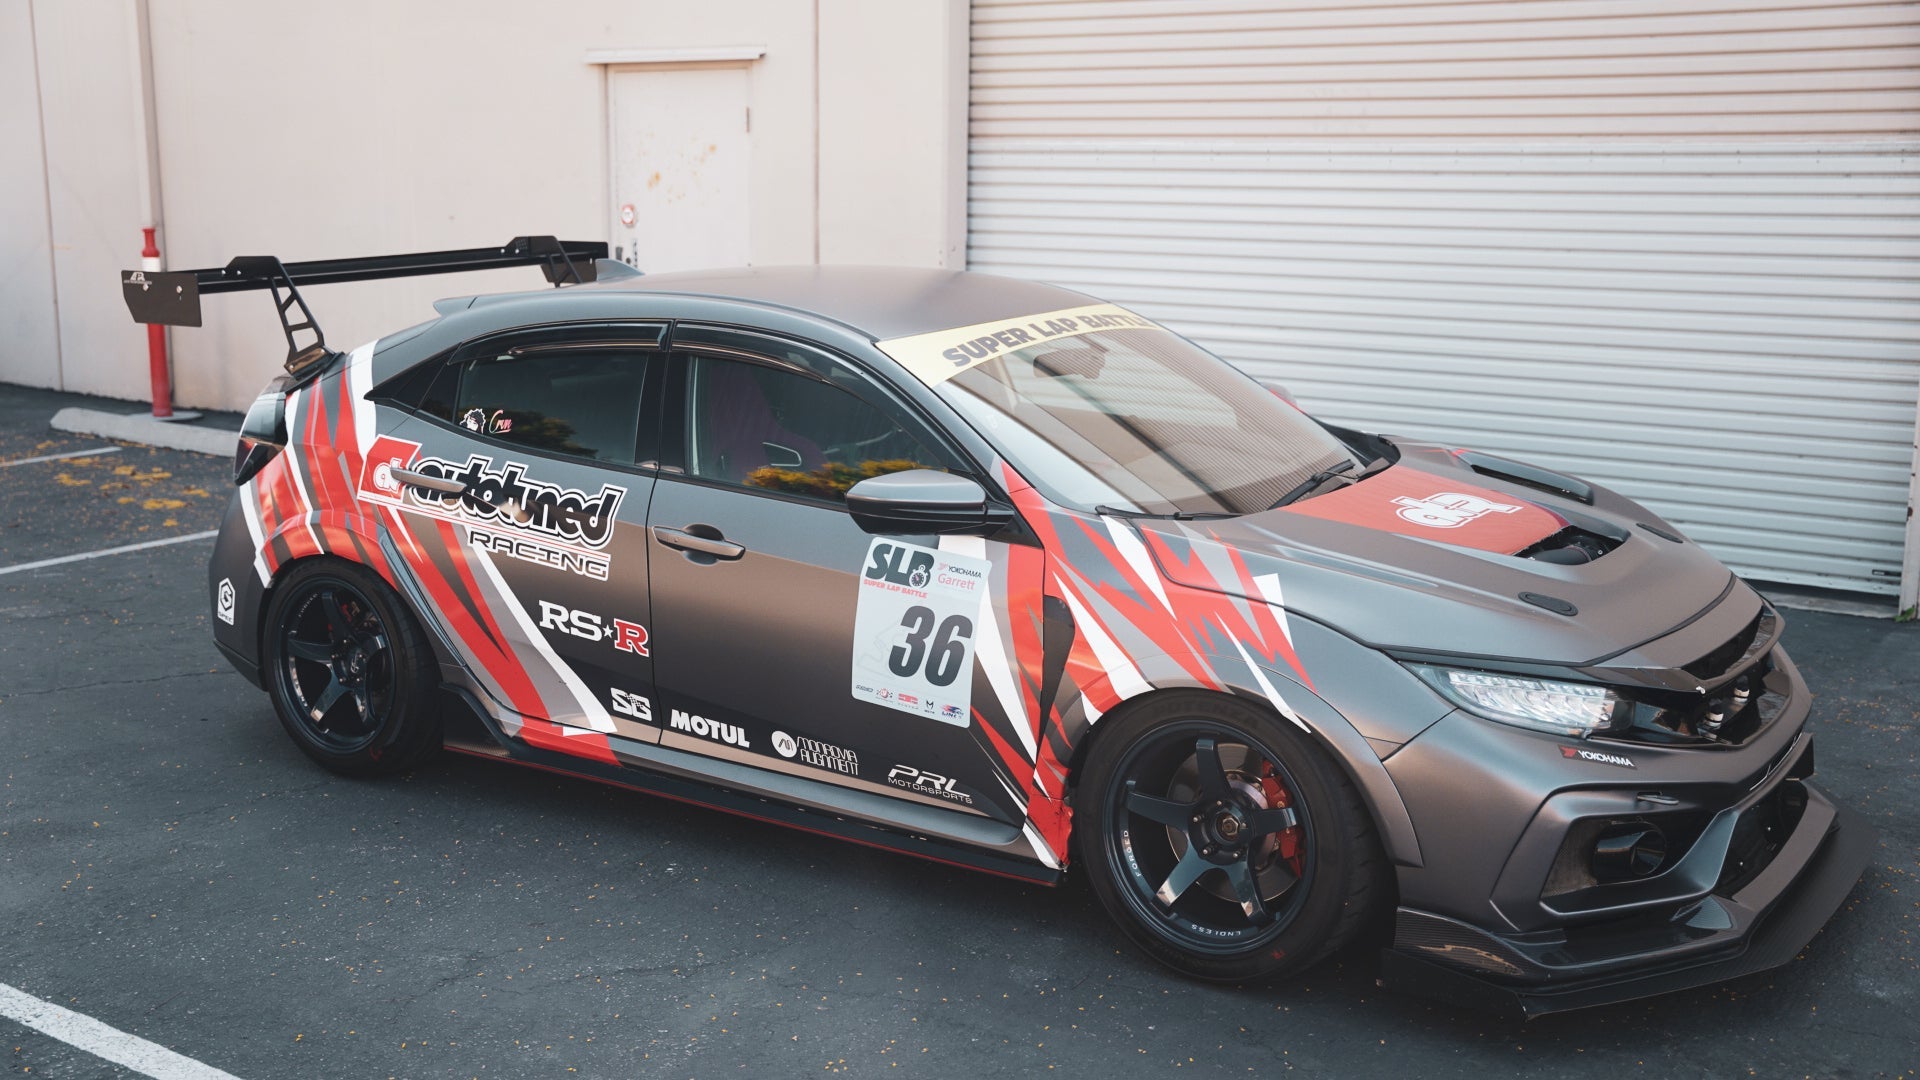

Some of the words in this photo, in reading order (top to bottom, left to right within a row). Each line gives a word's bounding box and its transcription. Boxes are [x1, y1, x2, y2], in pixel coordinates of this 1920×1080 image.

[942, 326, 1034, 368] SUPER
[1028, 314, 1079, 340] LAP
[467, 529, 611, 581] RACING
[865, 543, 935, 589] SLB
[937, 573, 976, 591] Garrett
[948, 564, 982, 579] YOKOHAMA
[863, 578, 886, 589] SUPER
[886, 583, 902, 592] LAP
[901, 587, 928, 599] BATTLE
[888, 604, 973, 687] 36
[670, 708, 750, 749] MOTUL
[796, 736, 858, 763] MONROVIA
[800, 748, 859, 776] ALIGNMENT
[1577, 749, 1635, 767] YOKOHAMA
[887, 777, 973, 804] MOTORSPORTS
[888, 764, 970, 798] PRL
[1122, 829, 1142, 878] FORGED
[1190, 923, 1242, 937] ENDLESS
